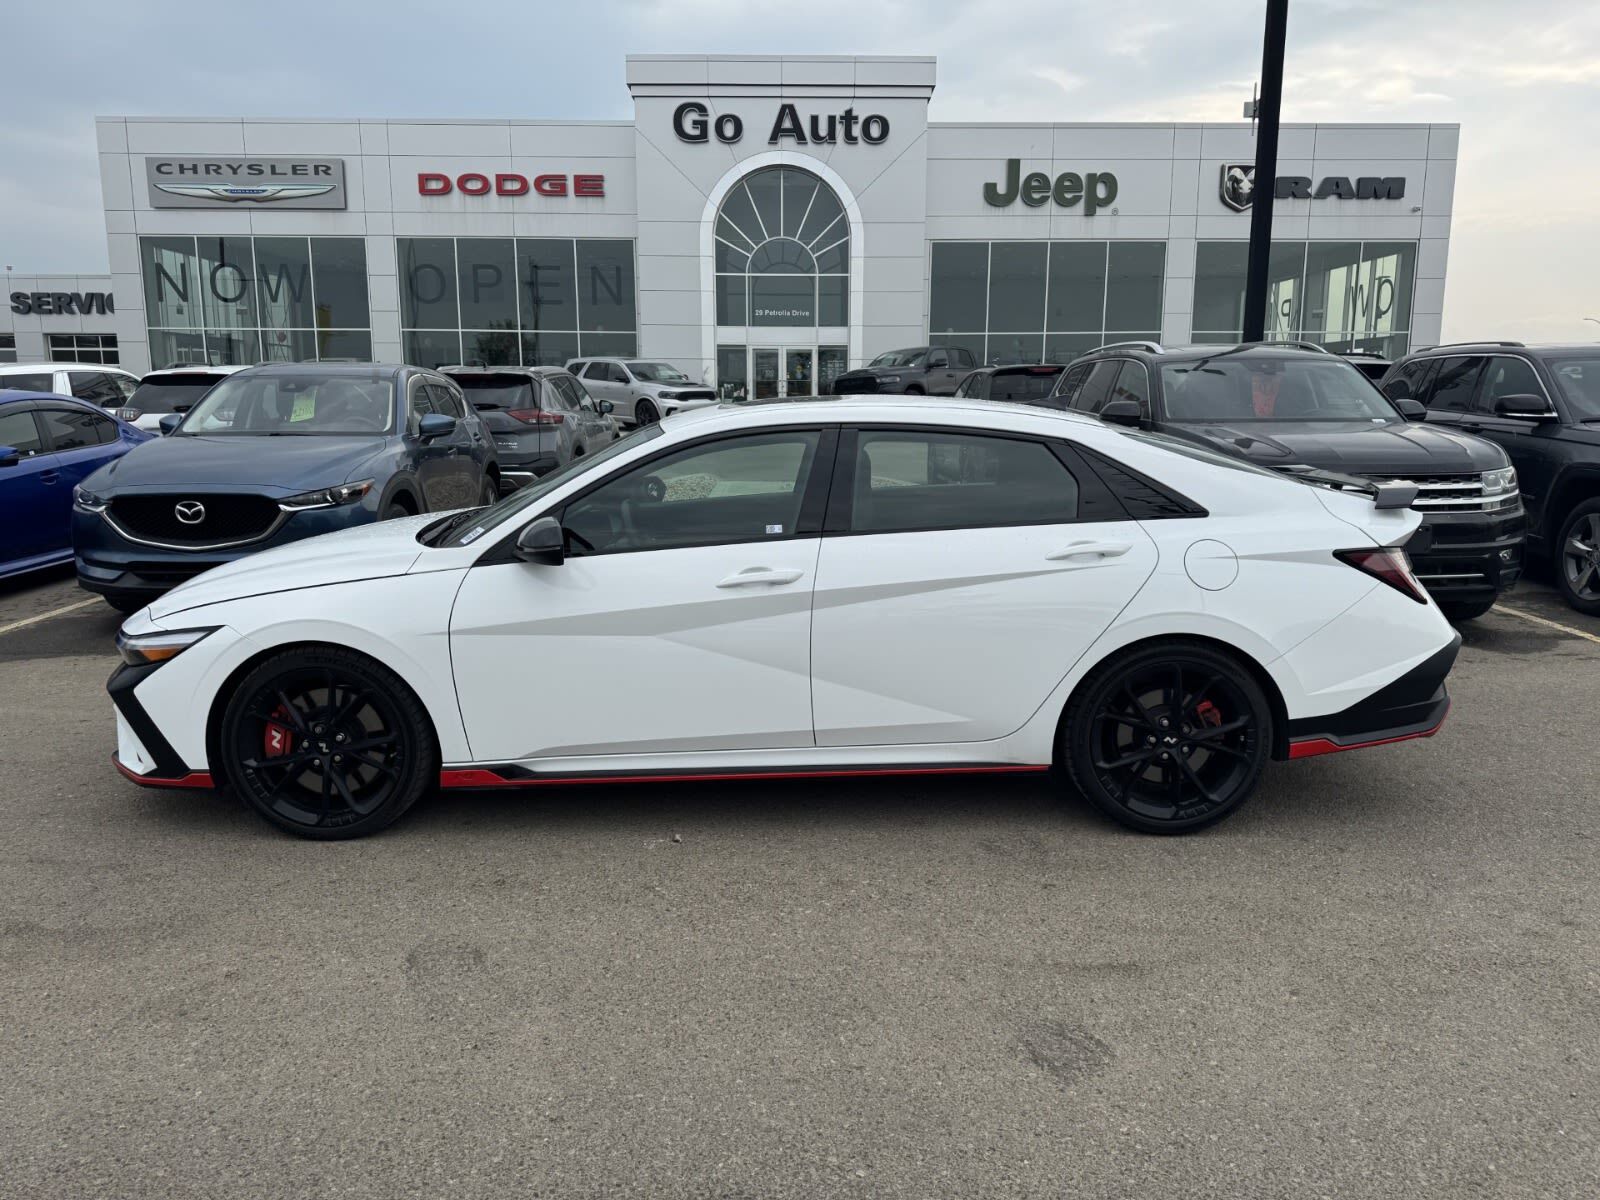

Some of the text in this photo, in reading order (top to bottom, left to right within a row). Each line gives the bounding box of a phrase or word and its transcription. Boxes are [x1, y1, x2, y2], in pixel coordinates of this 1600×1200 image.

[673, 102, 890, 144] Go Auto
[155, 163, 332, 176] CHRYSLER
[418, 173, 605, 197] DODGE
[983, 158, 1118, 216] Jeep
[1275, 176, 1406, 199] RAM
[155, 262, 623, 305] NOW OPEN
